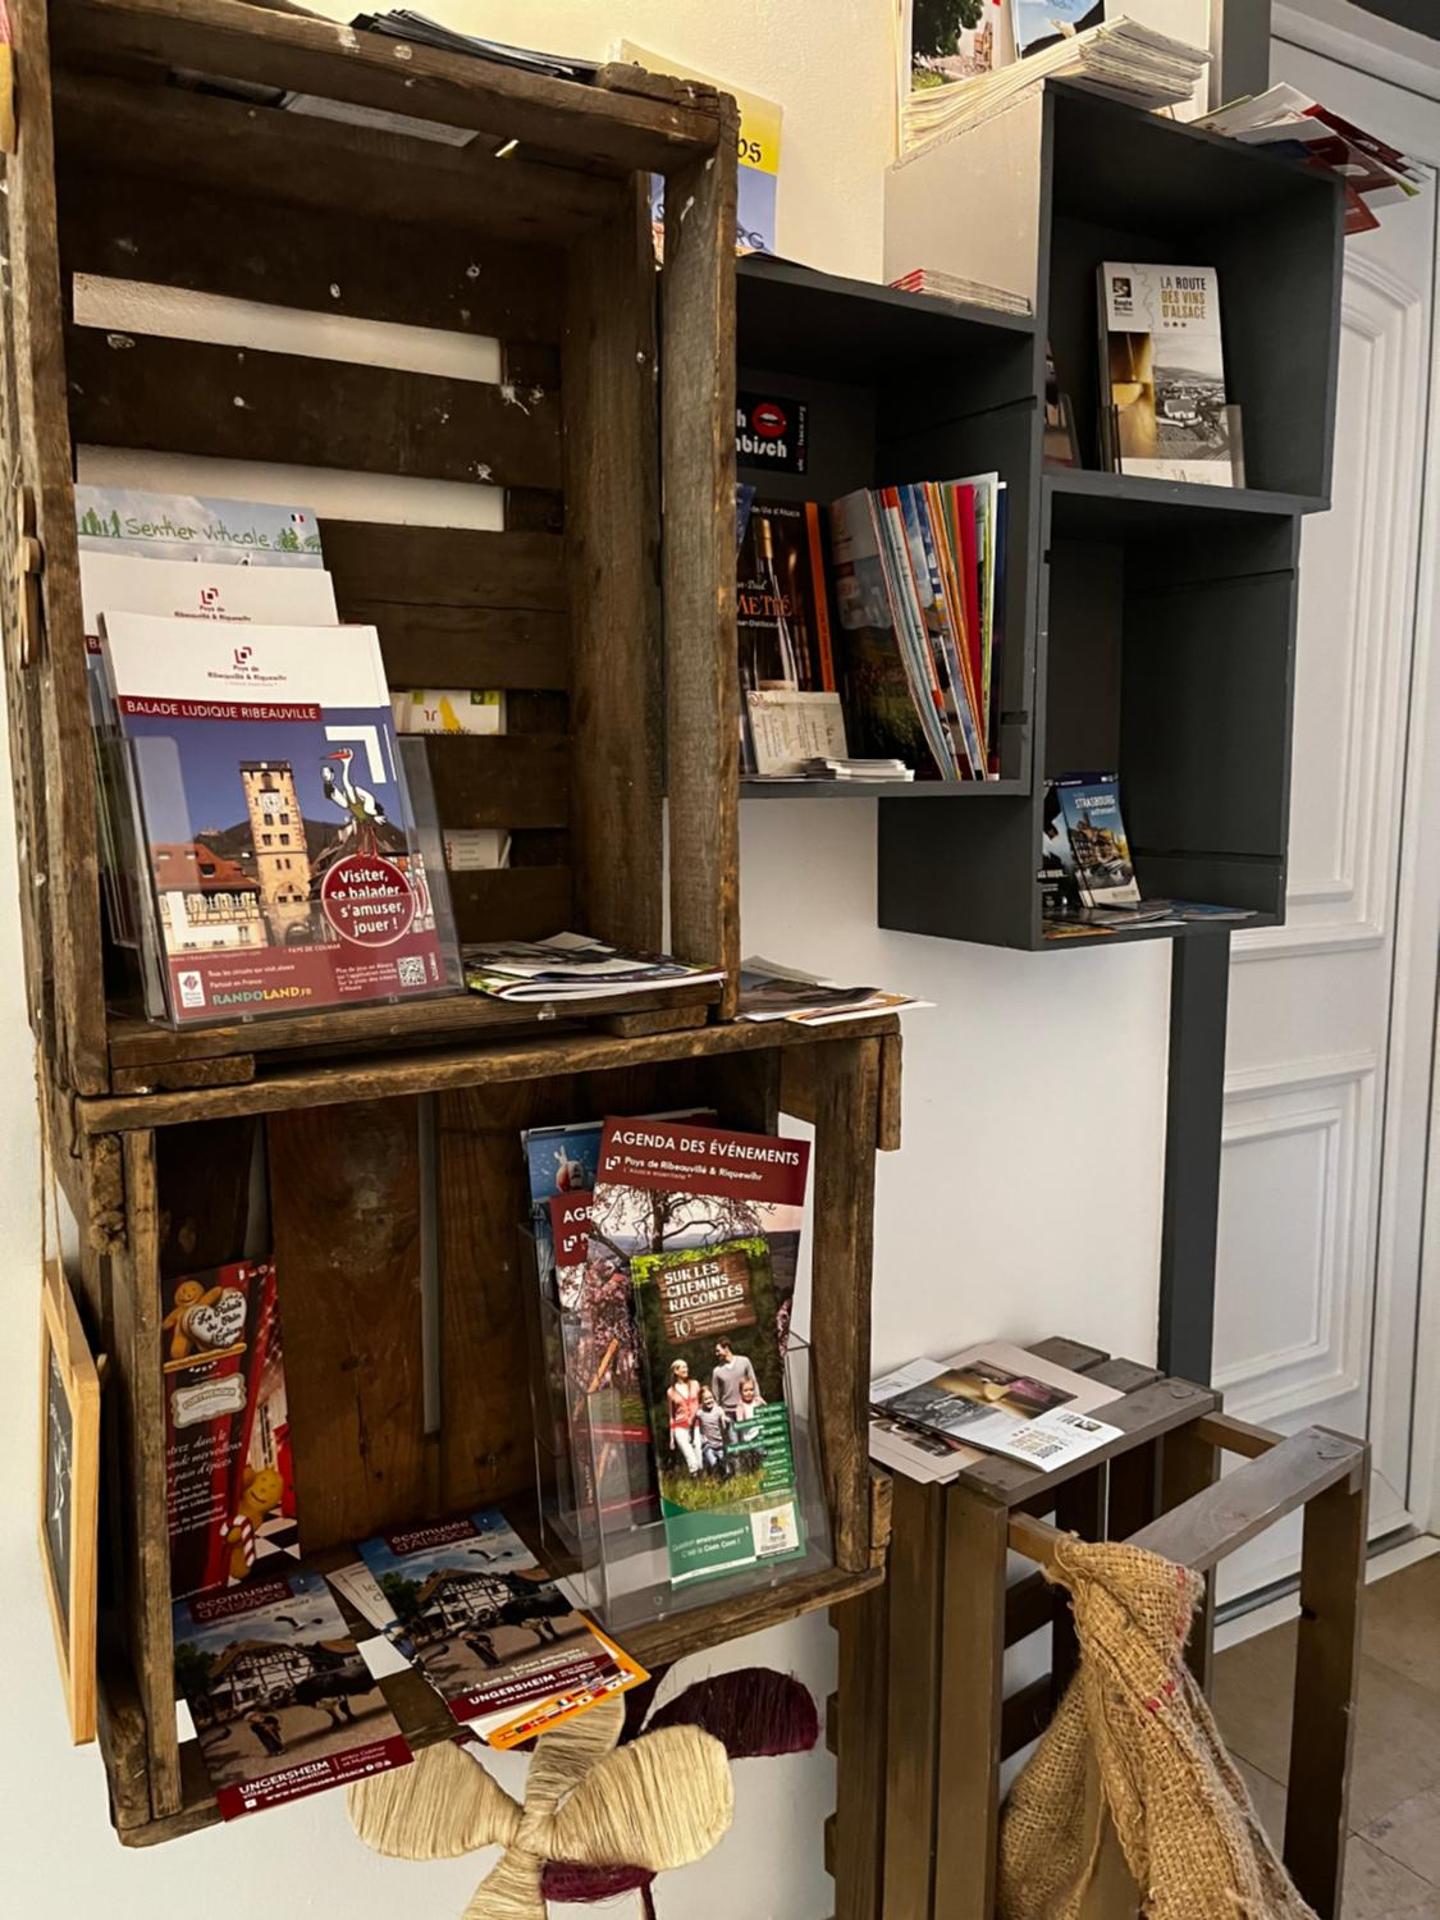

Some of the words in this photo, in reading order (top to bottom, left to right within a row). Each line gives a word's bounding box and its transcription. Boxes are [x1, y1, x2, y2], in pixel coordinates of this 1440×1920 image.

[1160, 276, 1172, 289] LA
[1175, 277, 1206, 291] ROUTE
[1160, 290, 1179, 304] DES
[1182, 292, 1205, 305] VINS
[1161, 304, 1206, 319] D'ALSACE
[125, 514, 197, 539] Sentier
[127, 700, 179, 715] BALADE
[181, 704, 238, 718] LUDIQUE
[242, 707, 317, 719] RIBEAUVILLE
[339, 868, 388, 883] Visiter,
[341, 903, 405, 918] s'amuser,
[353, 920, 389, 938] jouer
[611, 1129, 676, 1151] AGENDA
[680, 1138, 706, 1154] DES
[709, 1138, 800, 1166] ÉVÉNEMENTS
[624, 1156, 645, 1168] Pays
[647, 1160, 659, 1168] de
[660, 1160, 707, 1175] Ribeauvillé
[709, 1167, 717, 1175] &
[719, 1167, 763, 1181] Riquewihr
[563, 1206, 594, 1224] AGE
[664, 1268, 692, 1285] SUR
[694, 1262, 719, 1277] LES
[667, 1273, 729, 1297] CHEMINS
[468, 1673, 557, 1705] UNGERSHEIM
[238, 1759, 331, 1795] UNGERSHEIM
